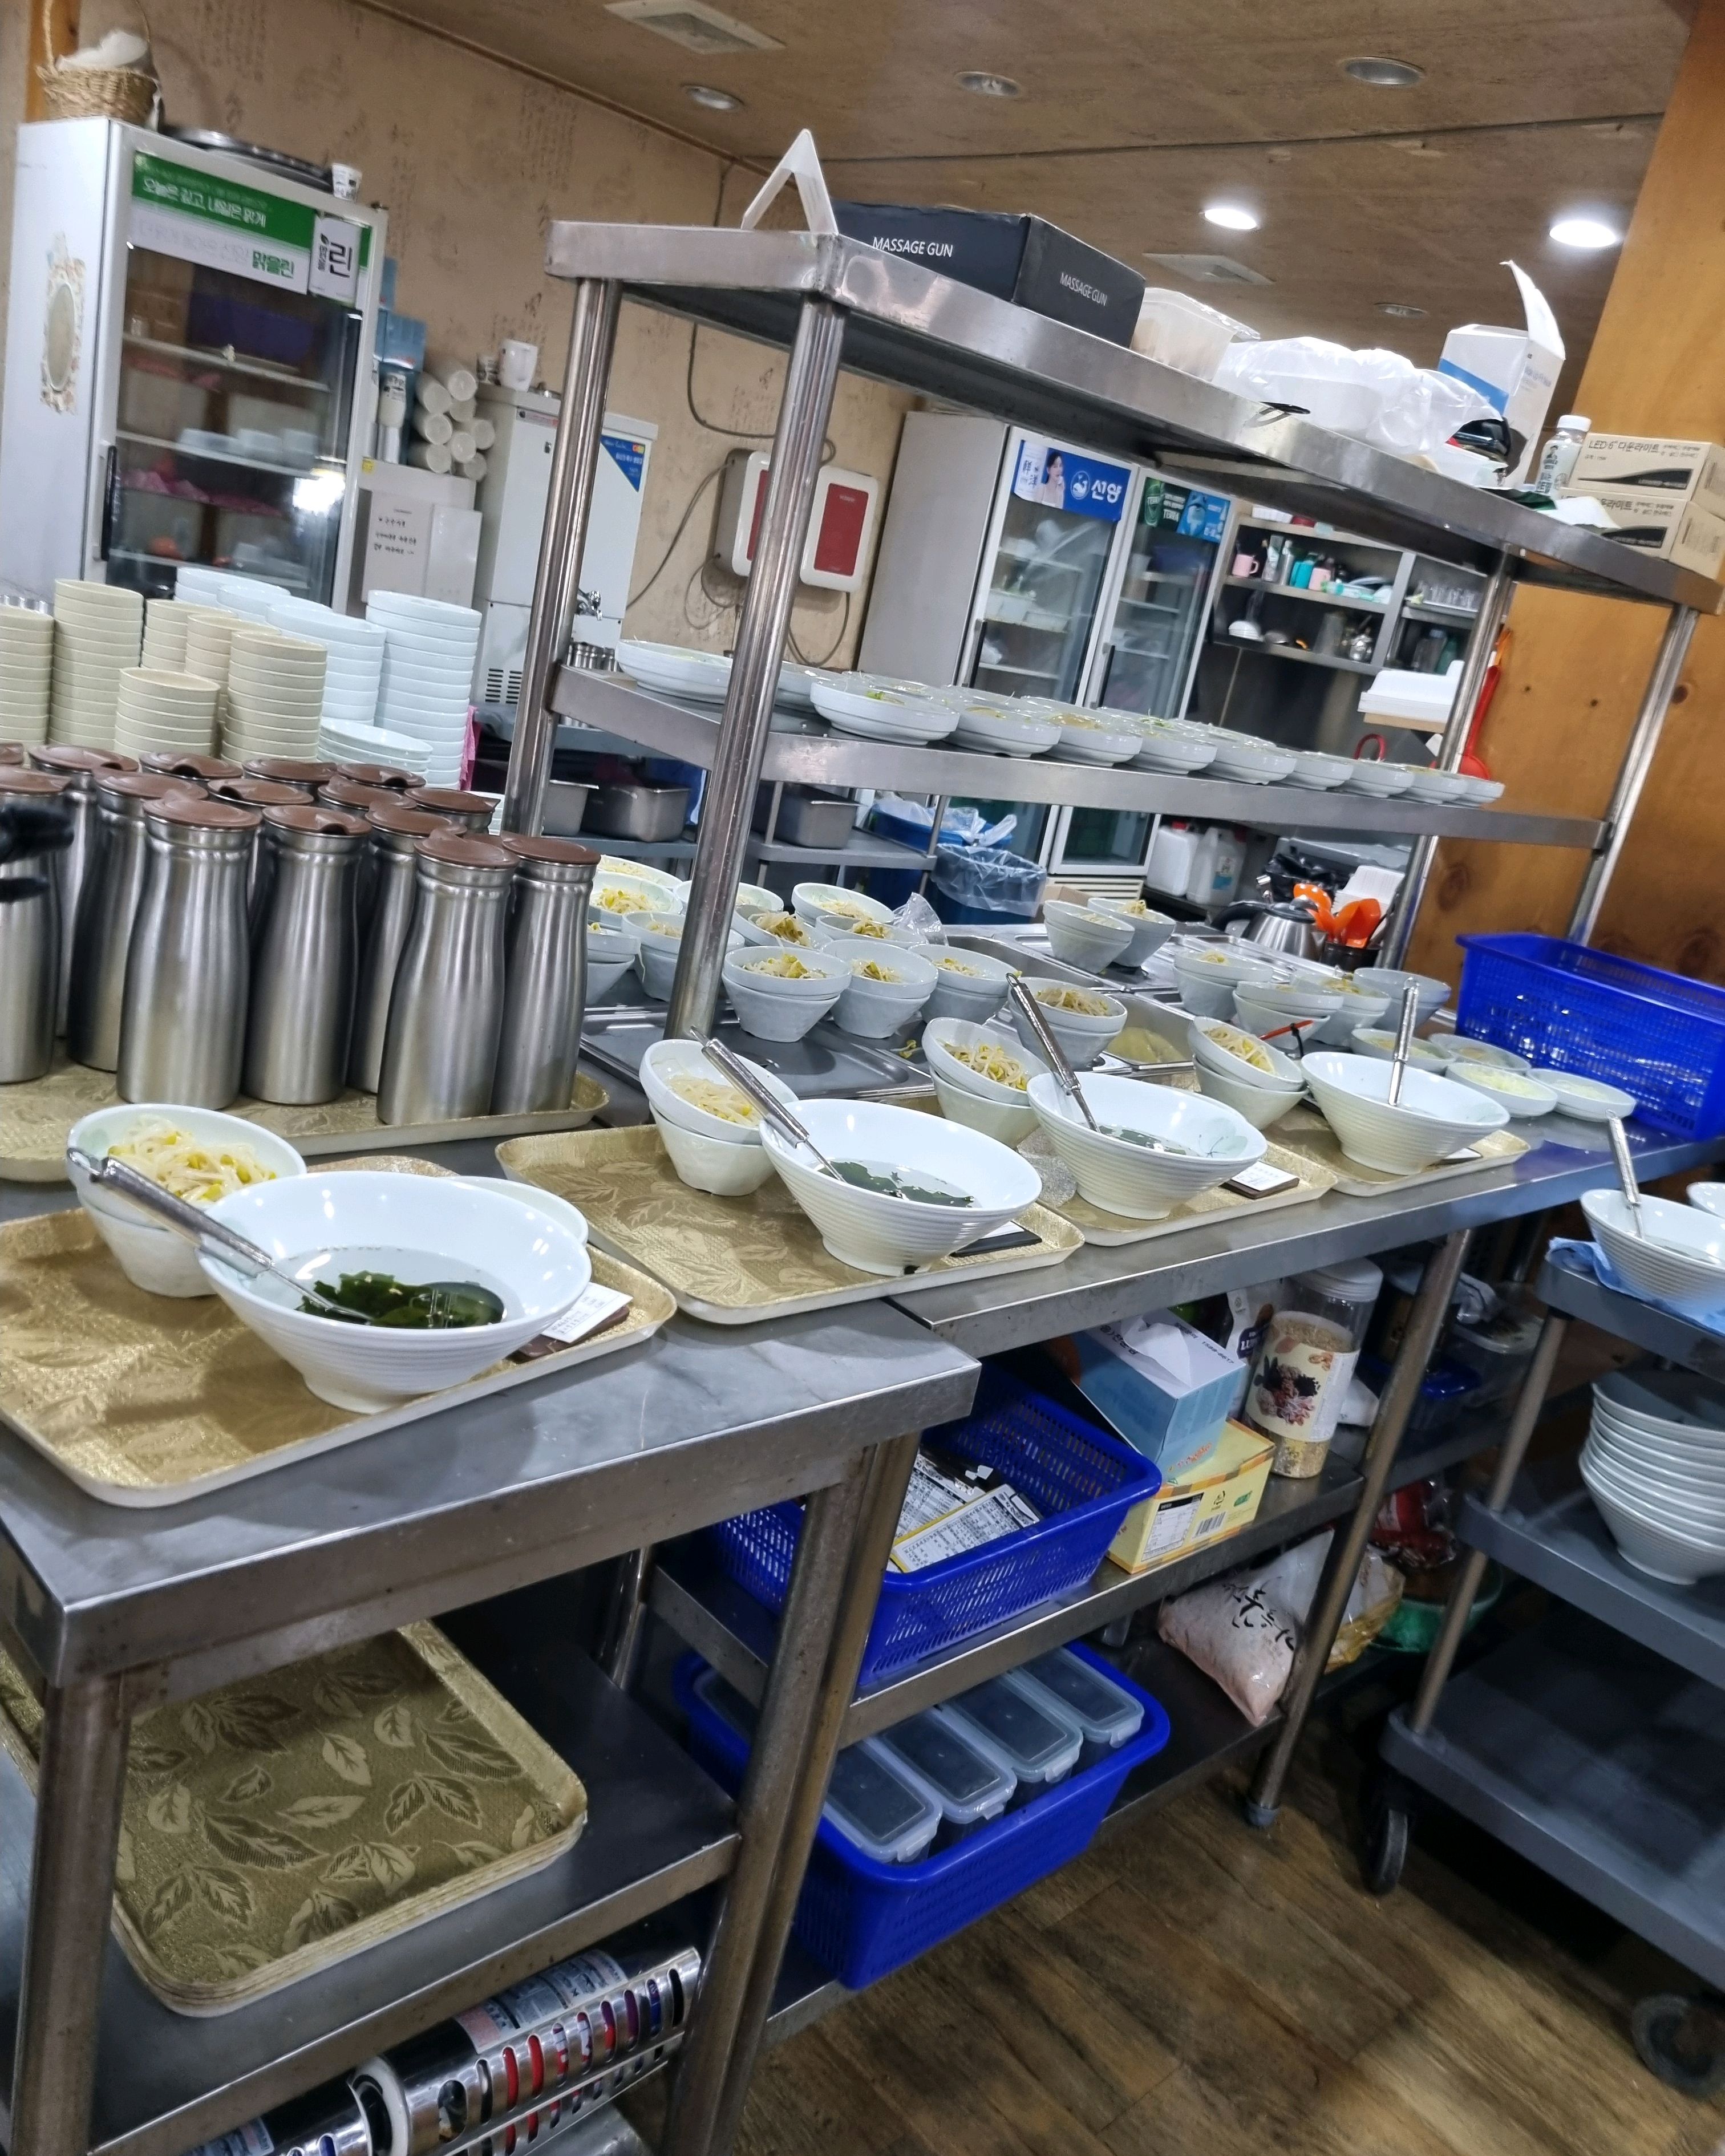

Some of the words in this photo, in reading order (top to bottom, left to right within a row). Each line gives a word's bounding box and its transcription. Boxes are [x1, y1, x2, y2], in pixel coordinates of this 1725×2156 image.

[872, 236, 926, 256] MASSAGE
[927, 242, 953, 258] GUN
[1060, 271, 1093, 299] MASSAGE
[1091, 289, 1108, 306] GUN
[1588, 440, 1607, 449] LED
